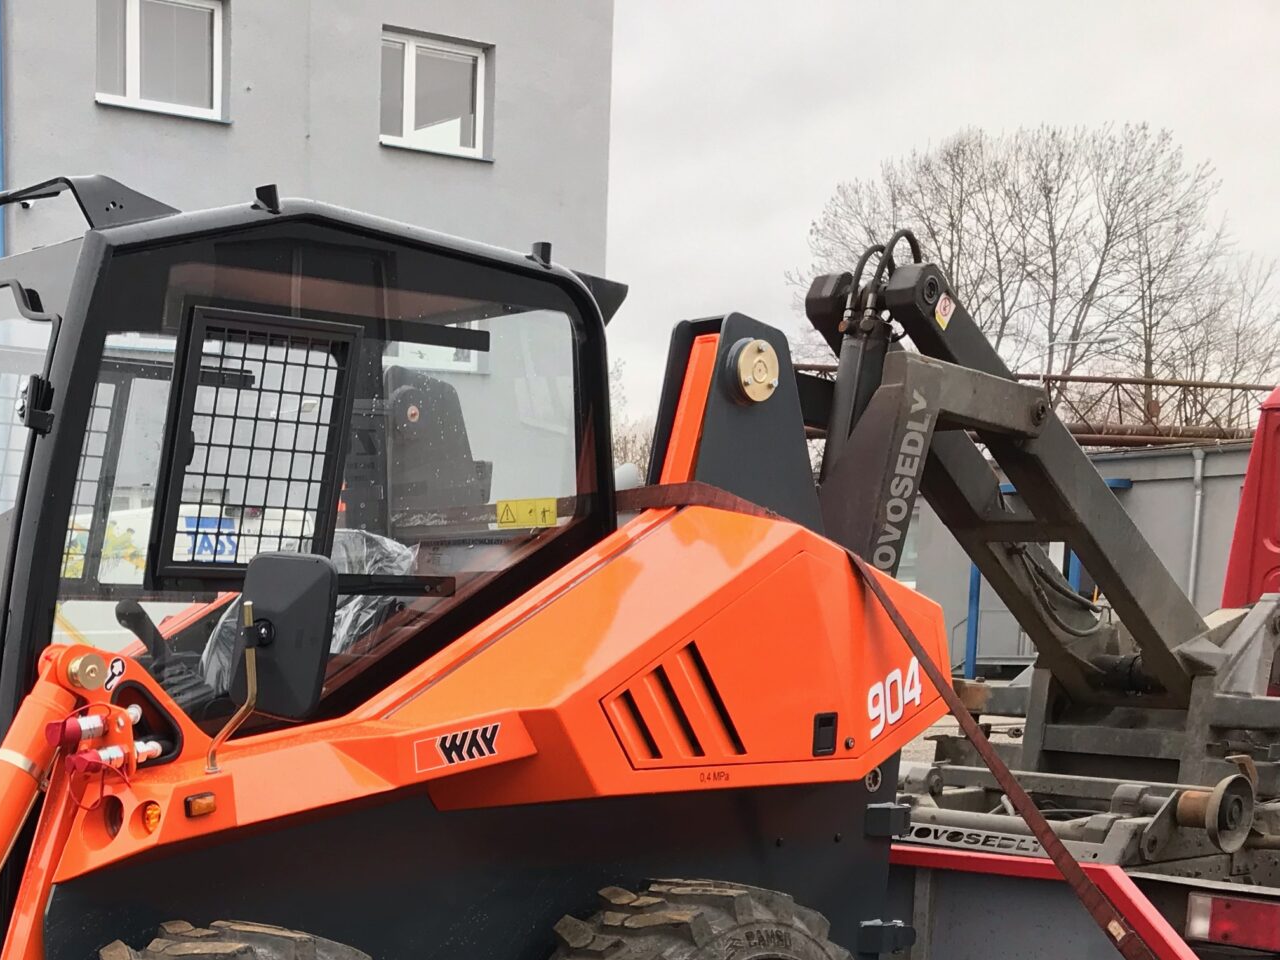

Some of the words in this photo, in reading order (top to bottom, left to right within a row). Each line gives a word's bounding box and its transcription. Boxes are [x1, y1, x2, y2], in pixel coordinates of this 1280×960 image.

[872, 388, 933, 579] OVOSEDLY
[867, 655, 922, 741] 904
[438, 723, 501, 766] WAY
[910, 826, 1044, 852] OVOSEDLY
